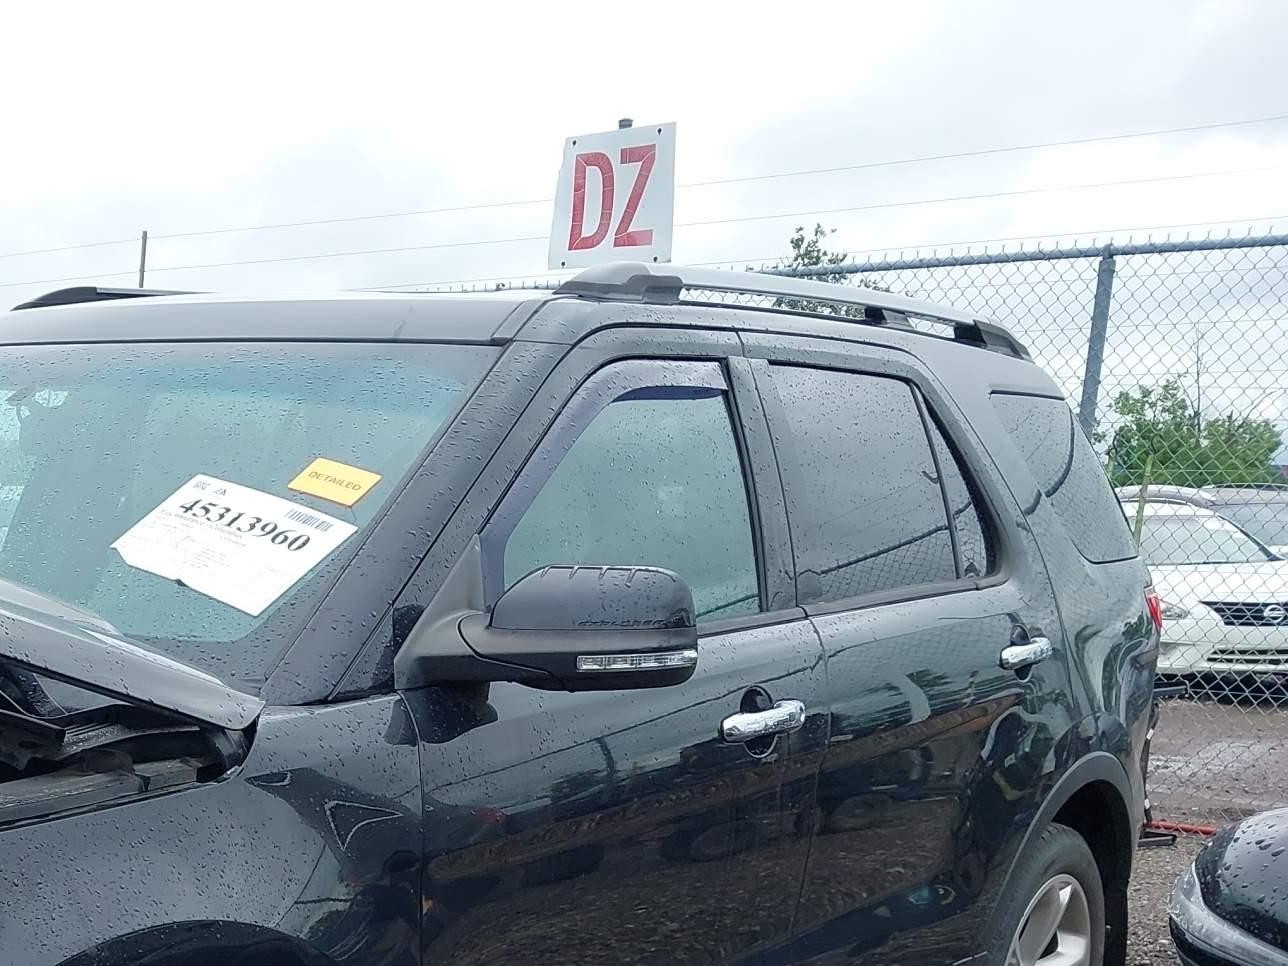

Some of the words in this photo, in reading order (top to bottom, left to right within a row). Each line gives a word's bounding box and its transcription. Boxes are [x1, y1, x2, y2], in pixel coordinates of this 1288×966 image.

[568, 144, 656, 251] DZ
[308, 471, 362, 491] DETAILED
[180, 499, 311, 551] 45313960
